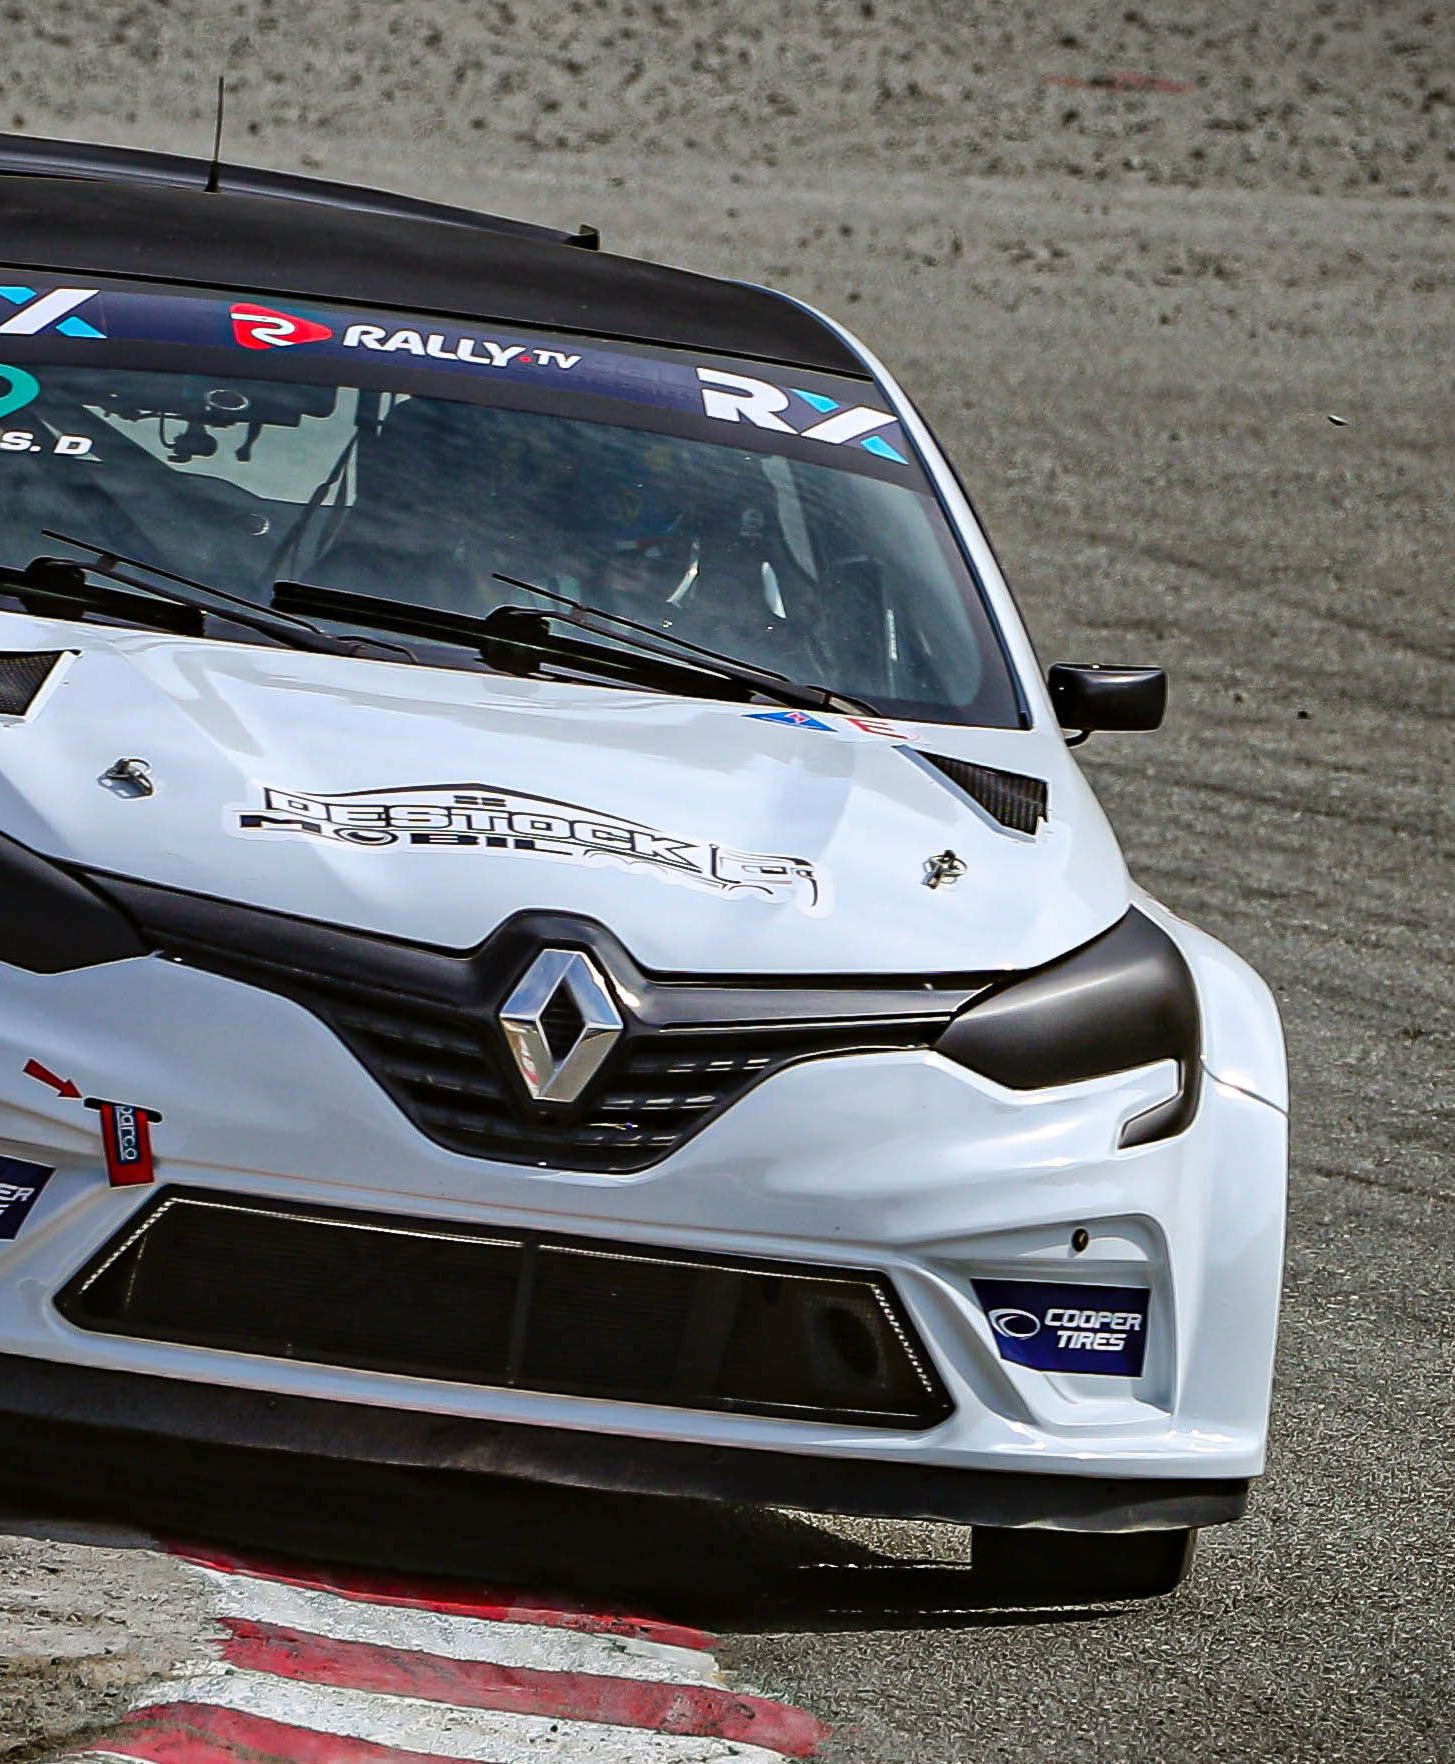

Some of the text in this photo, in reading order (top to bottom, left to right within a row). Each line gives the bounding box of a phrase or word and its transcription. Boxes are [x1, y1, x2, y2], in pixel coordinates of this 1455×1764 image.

[696, 367, 910, 465] RX
[53, 435, 94, 456] D
[263, 787, 703, 872] DESTOCK
[115, 1105, 138, 1161] parco
[1044, 1308, 1143, 1331] COOPER
[1056, 1330, 1128, 1352] TIRES
